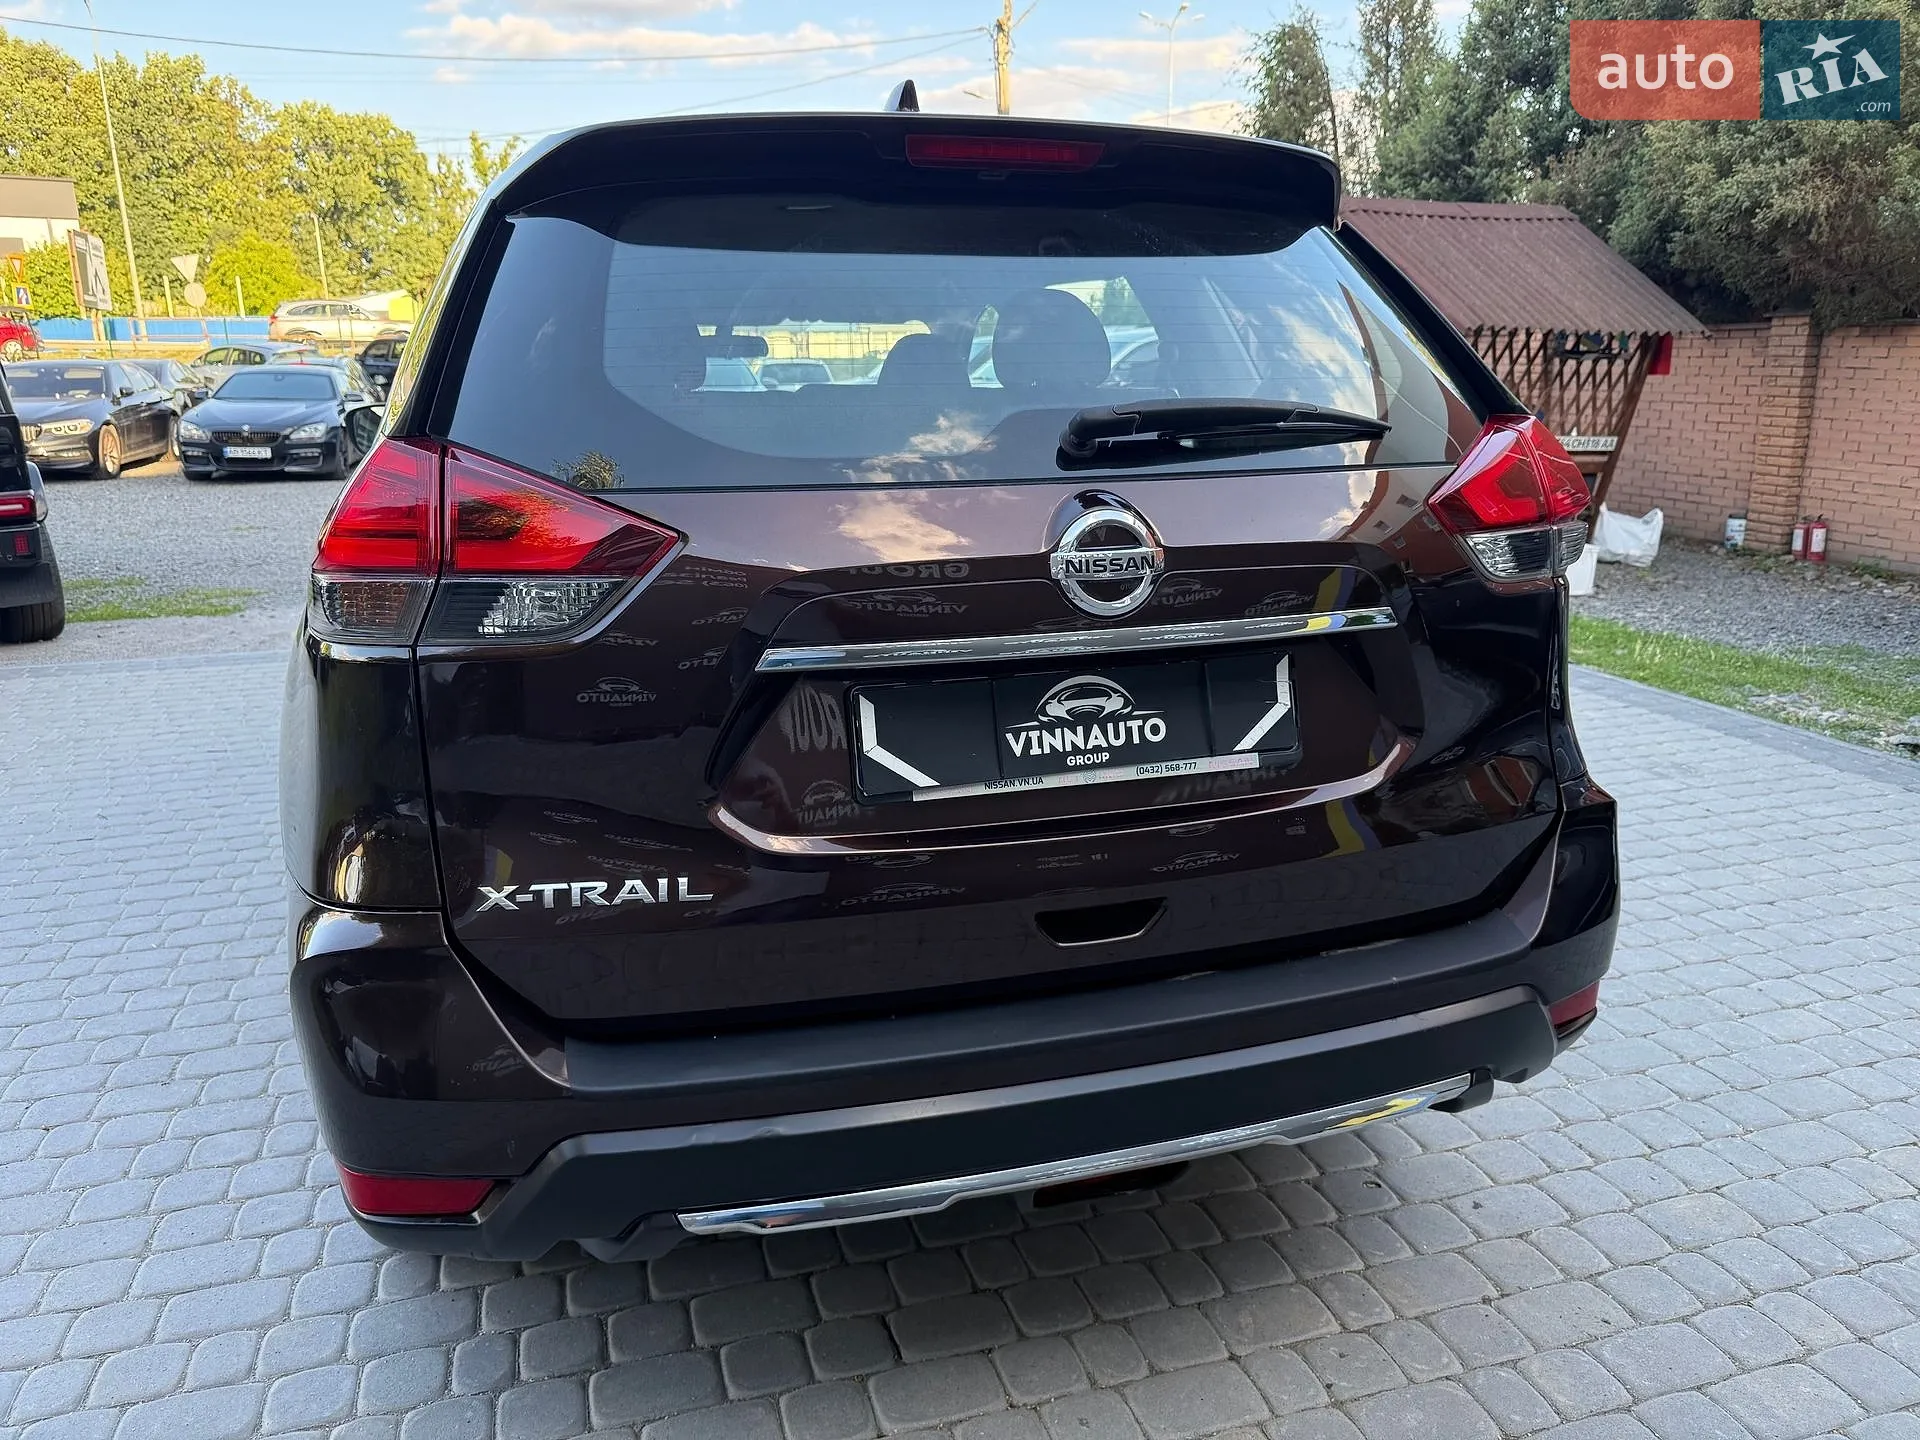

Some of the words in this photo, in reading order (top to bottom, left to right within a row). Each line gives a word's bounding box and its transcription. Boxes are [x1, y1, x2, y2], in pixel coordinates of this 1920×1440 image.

[1064, 555, 1155, 574] NISSAN
[1005, 717, 1167, 757] VINNAUTO
[1066, 752, 1110, 766] GROUP
[984, 777, 1044, 790] NISSAN.VN.UA
[1136, 765, 1163, 776] (0432)
[1165, 761, 1197, 773] 568-777
[476, 876, 714, 912] X-TRAIL
